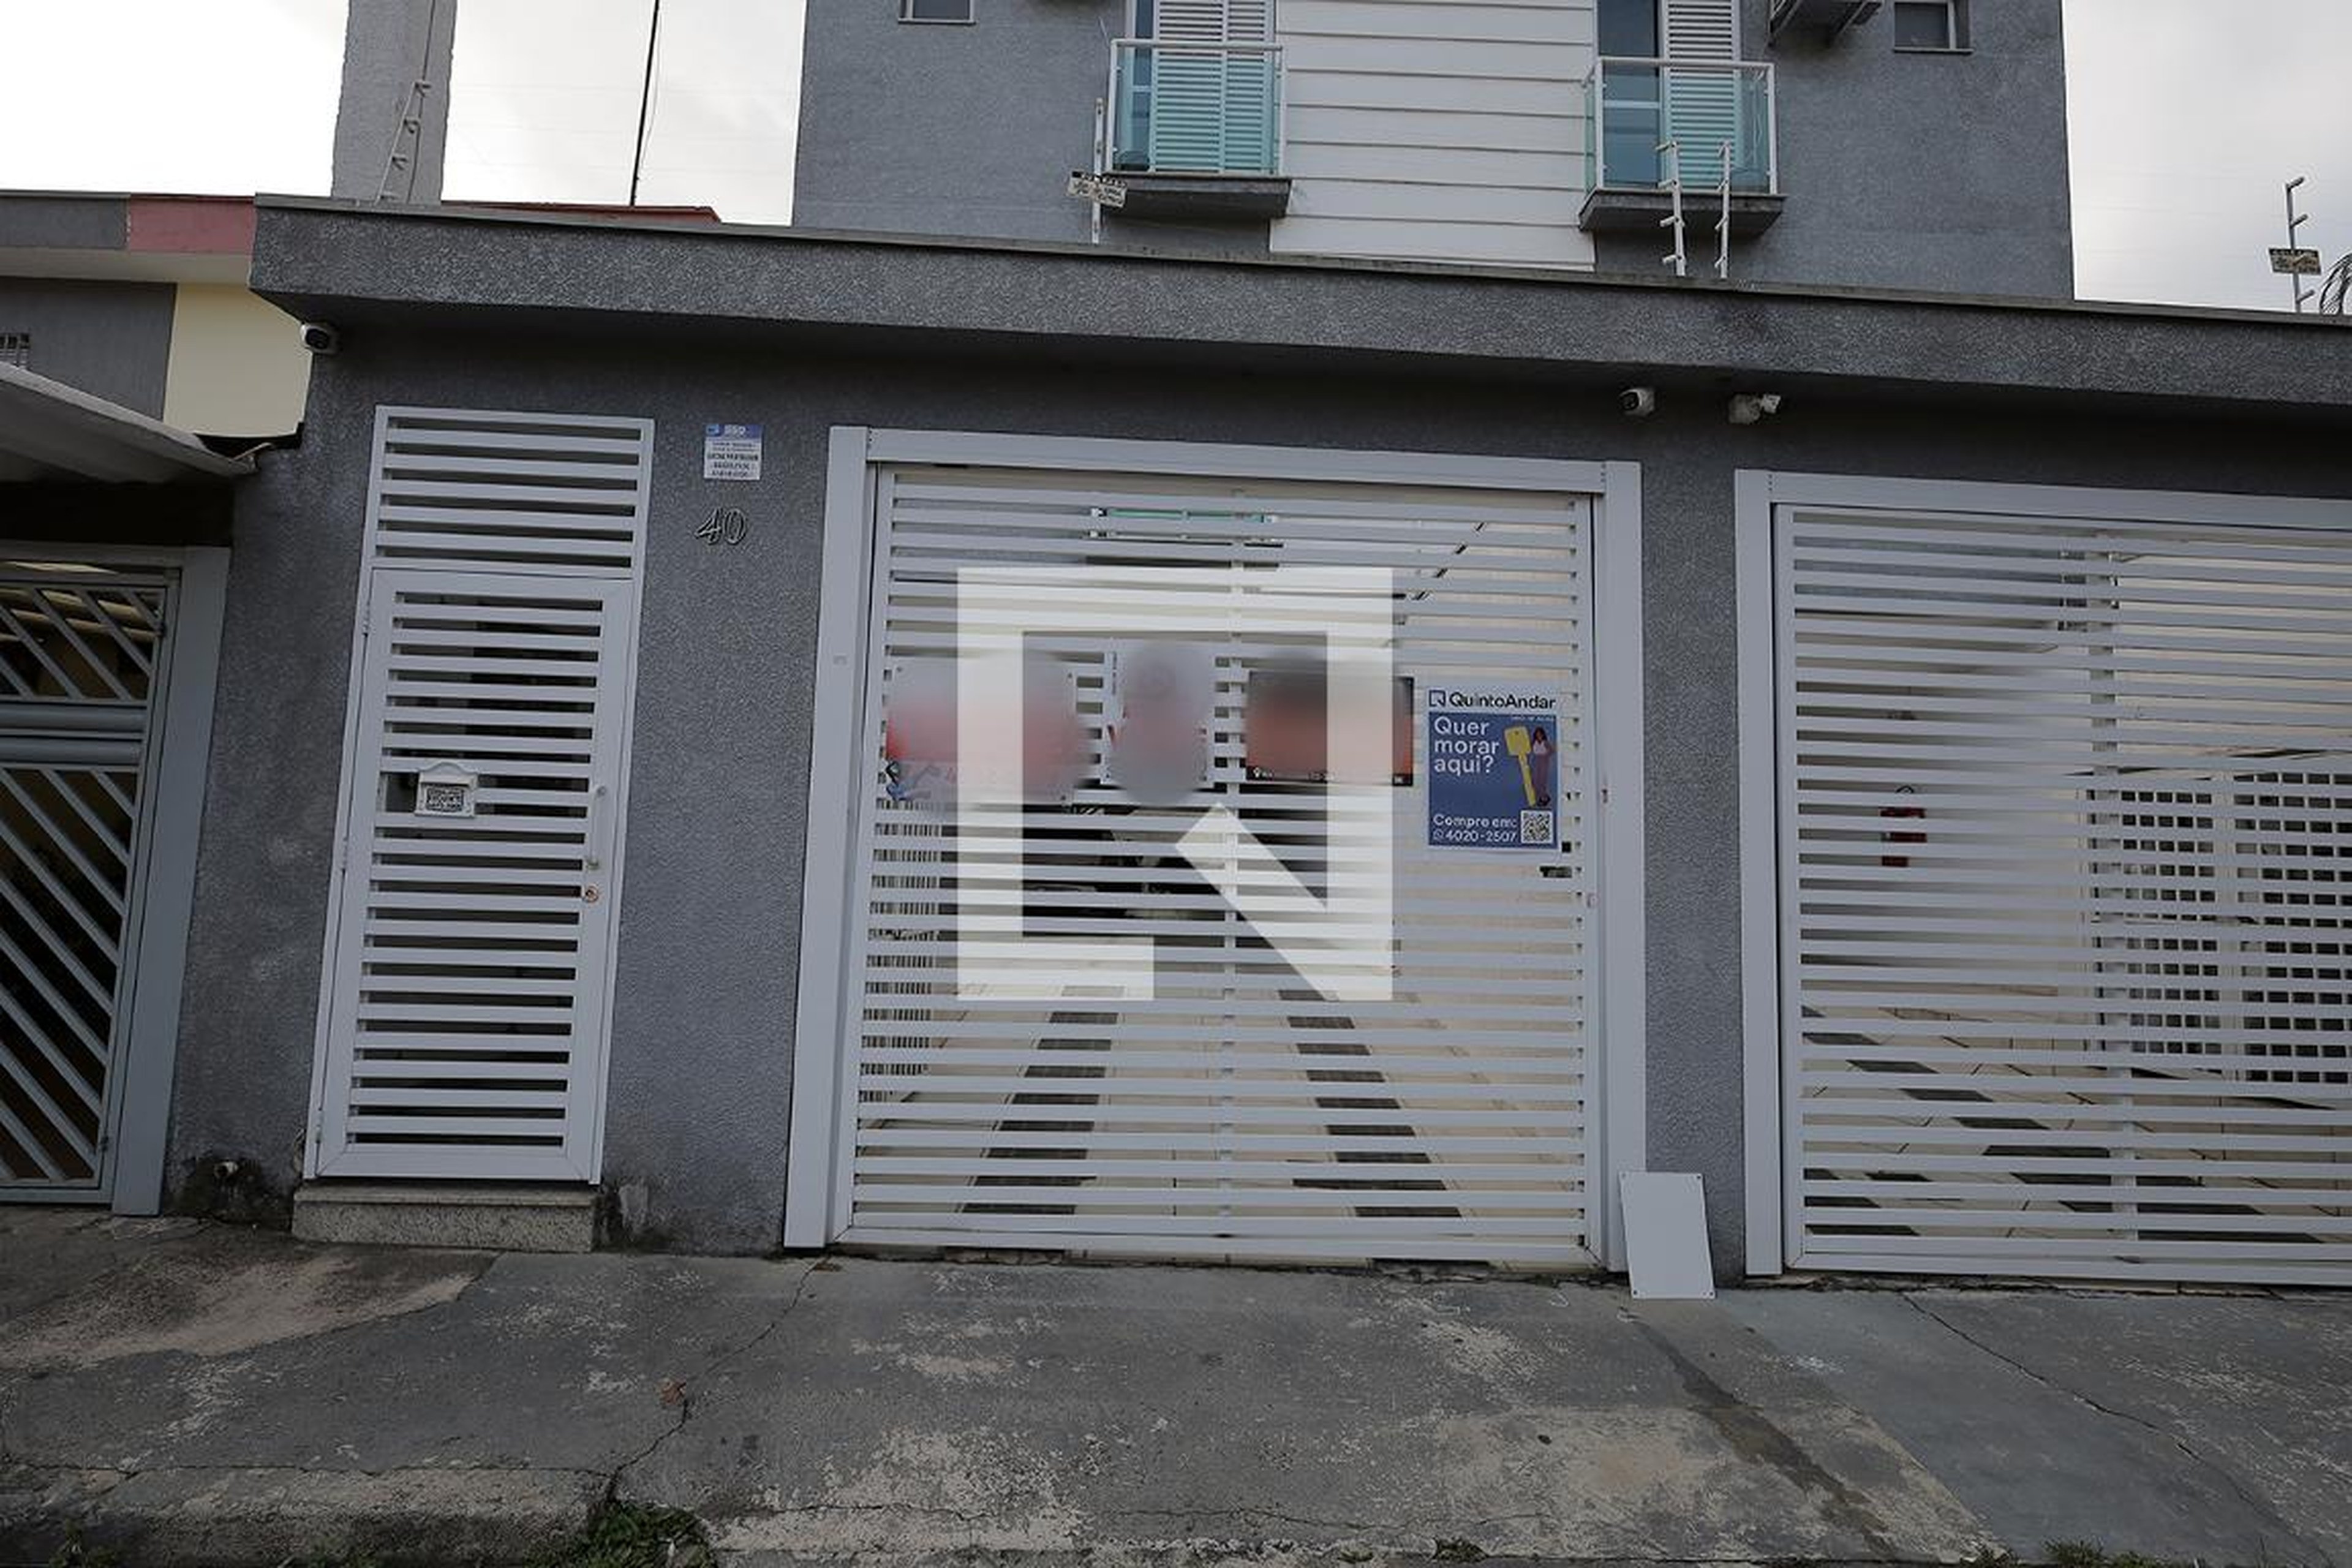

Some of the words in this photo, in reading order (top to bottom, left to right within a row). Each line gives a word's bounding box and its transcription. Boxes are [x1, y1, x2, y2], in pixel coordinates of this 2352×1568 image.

[694, 507, 747, 546] 40
[1449, 692, 1556, 709] QuintoAndar
[1434, 716, 1490, 735] Quer
[1434, 739, 1499, 755] morar
[1434, 755, 1494, 776] aqui?
[1446, 829, 1518, 843] 4020-2507
